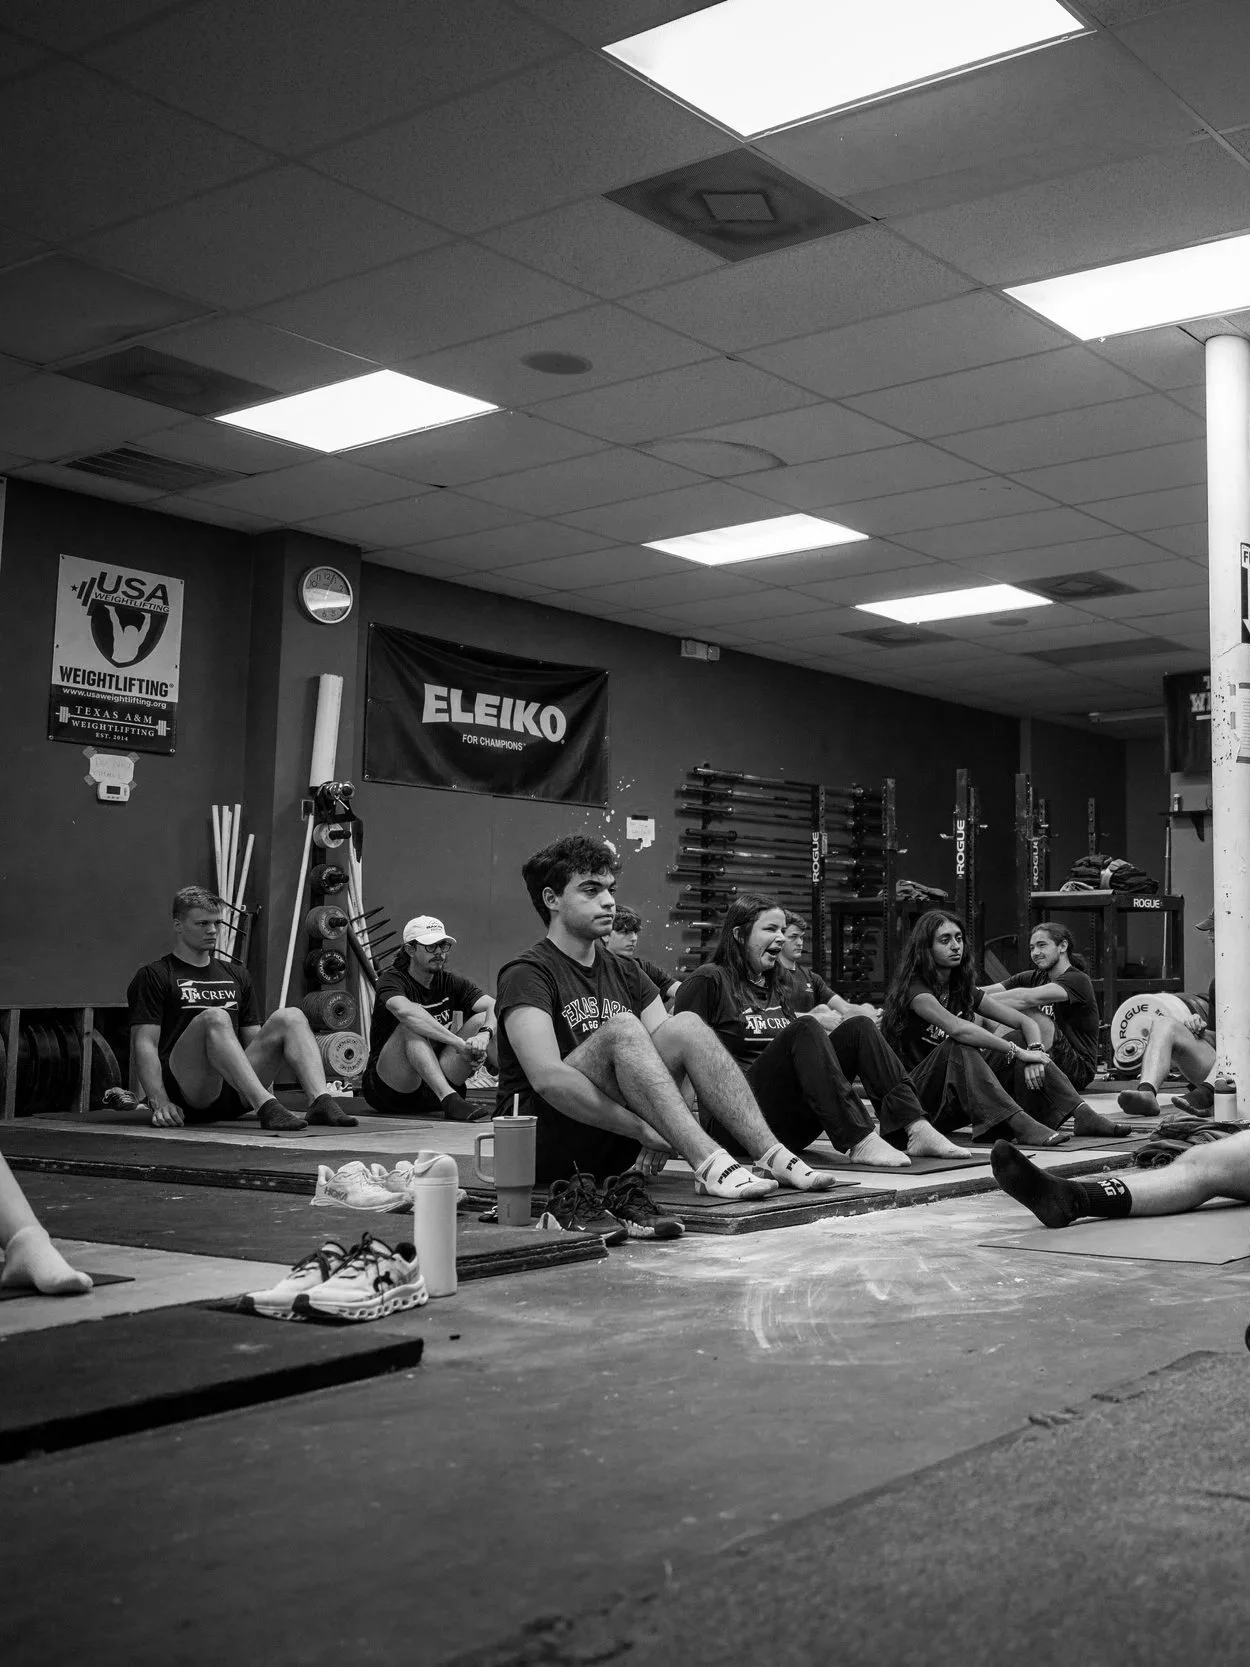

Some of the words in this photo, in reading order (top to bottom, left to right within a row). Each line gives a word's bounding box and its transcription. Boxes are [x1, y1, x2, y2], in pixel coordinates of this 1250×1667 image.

[94, 592, 170, 613] WEIGHTLIFTING
[97, 572, 169, 606] USA
[59, 665, 169, 698] WEIGHTLIFTING
[62, 687, 167, 710] www.usaweightlifting.org
[75, 705, 119, 720] TEXAS
[124, 712, 153, 724] A&M
[422, 683, 567, 743] ELEIKO
[72, 720, 155, 737] WEIGHTLIFTING
[462, 734, 478, 745] FOR
[480, 737, 524, 751] CHAMPIONS
[811, 831, 820, 884] ROGUE
[955, 819, 965, 877] ROGUE
[1133, 898, 1160, 909] ROGUE
[201, 990, 236, 1000] CREW
[561, 996, 600, 1029] TEXAS
[1119, 1003, 1149, 1039] ROGUE
